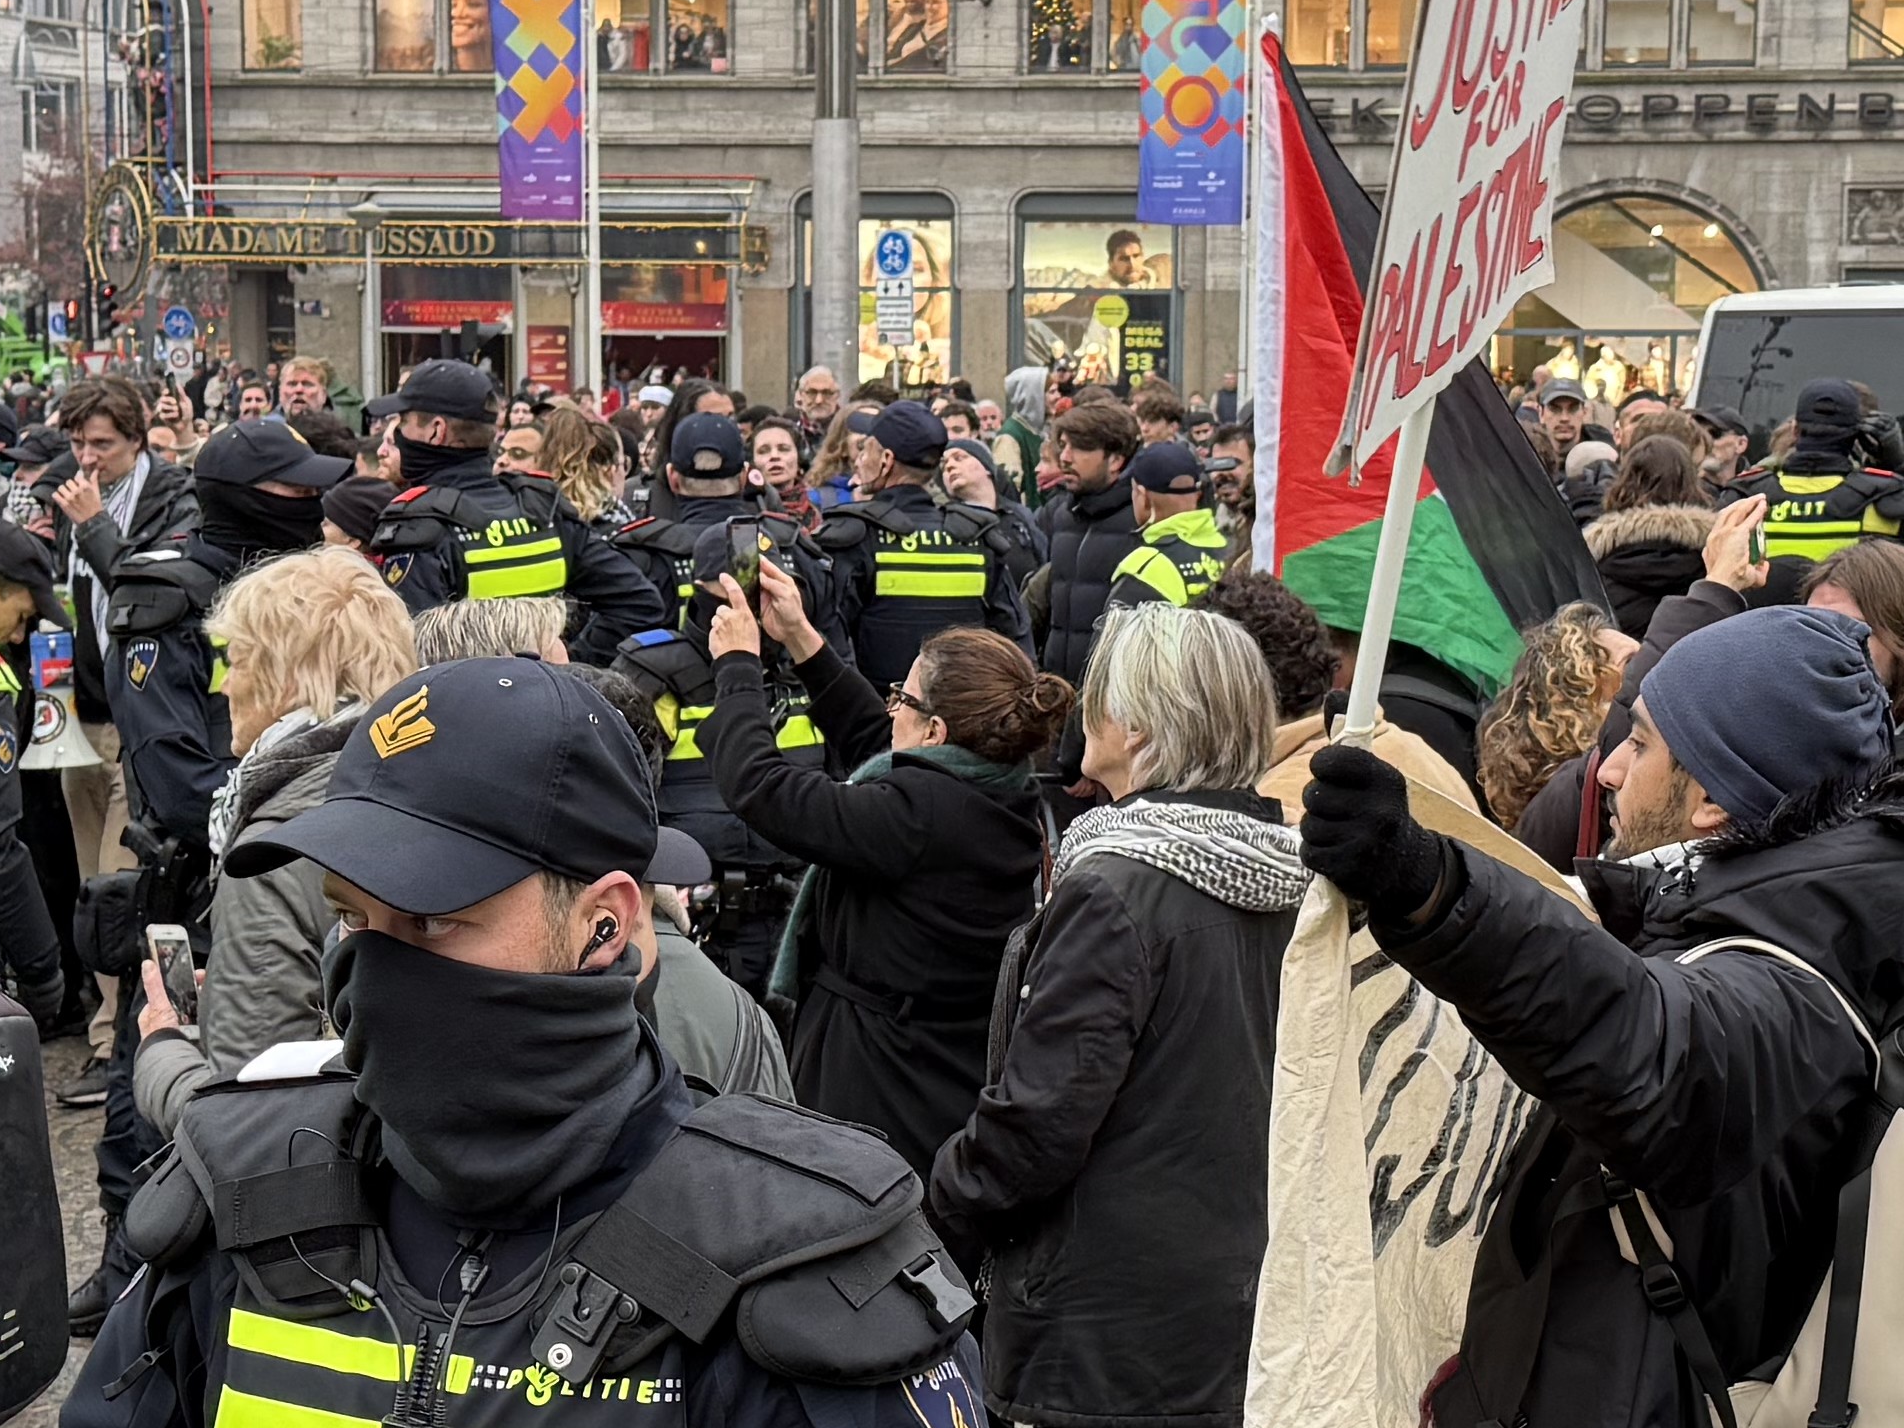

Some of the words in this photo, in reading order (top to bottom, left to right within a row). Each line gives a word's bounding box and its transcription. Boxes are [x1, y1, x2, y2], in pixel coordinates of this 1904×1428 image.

[1457, 59, 1527, 184] FOR
[176, 225, 327, 254] MADAME
[340, 227, 497, 257] TUSSAUD
[1365, 96, 1565, 431] PALESTINE
[1769, 501, 1824, 522] OLIT
[505, 1360, 654, 1407] POLITIE
